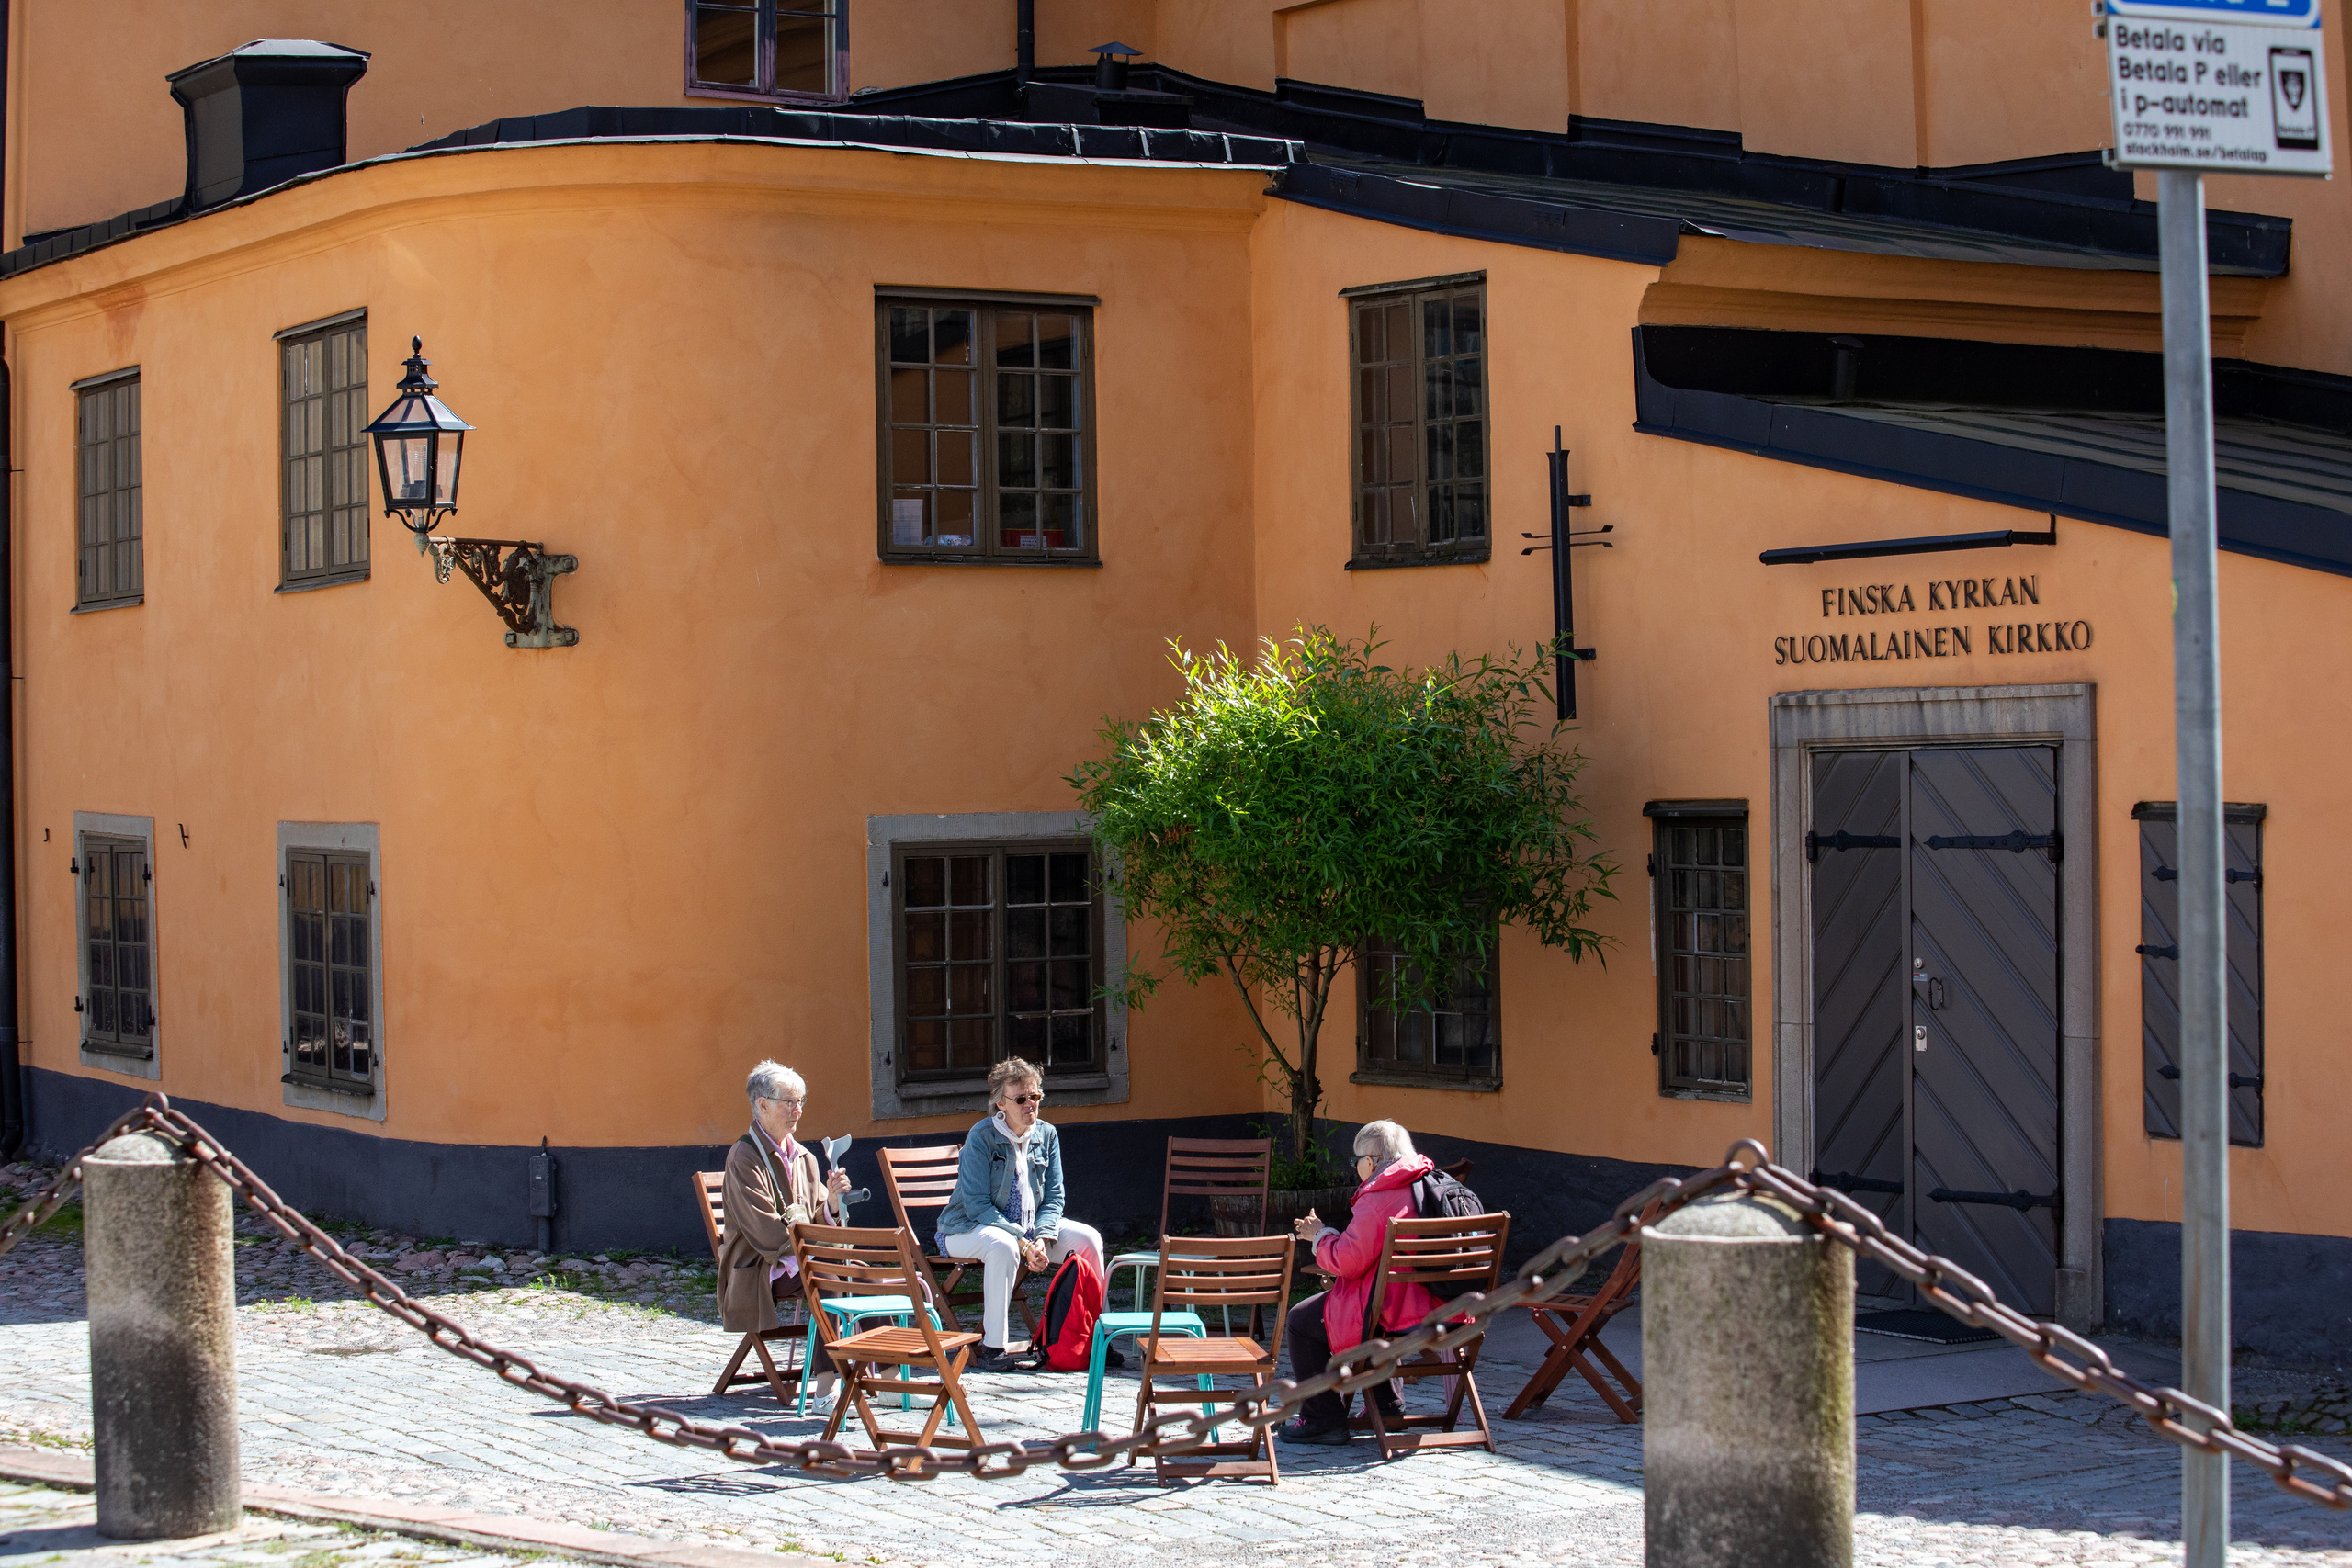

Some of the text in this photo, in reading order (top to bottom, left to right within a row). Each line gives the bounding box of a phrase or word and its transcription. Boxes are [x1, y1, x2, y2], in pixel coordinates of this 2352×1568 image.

[2115, 24, 2225, 54] Betala via
[2118, 55, 2262, 88] Betala P eller
[2120, 87, 2249, 118] i p-automat
[1821, 574, 2039, 617] FINSKA KYRKAN
[1775, 620, 2091, 665] SUOMALAINEN KIRKKO
